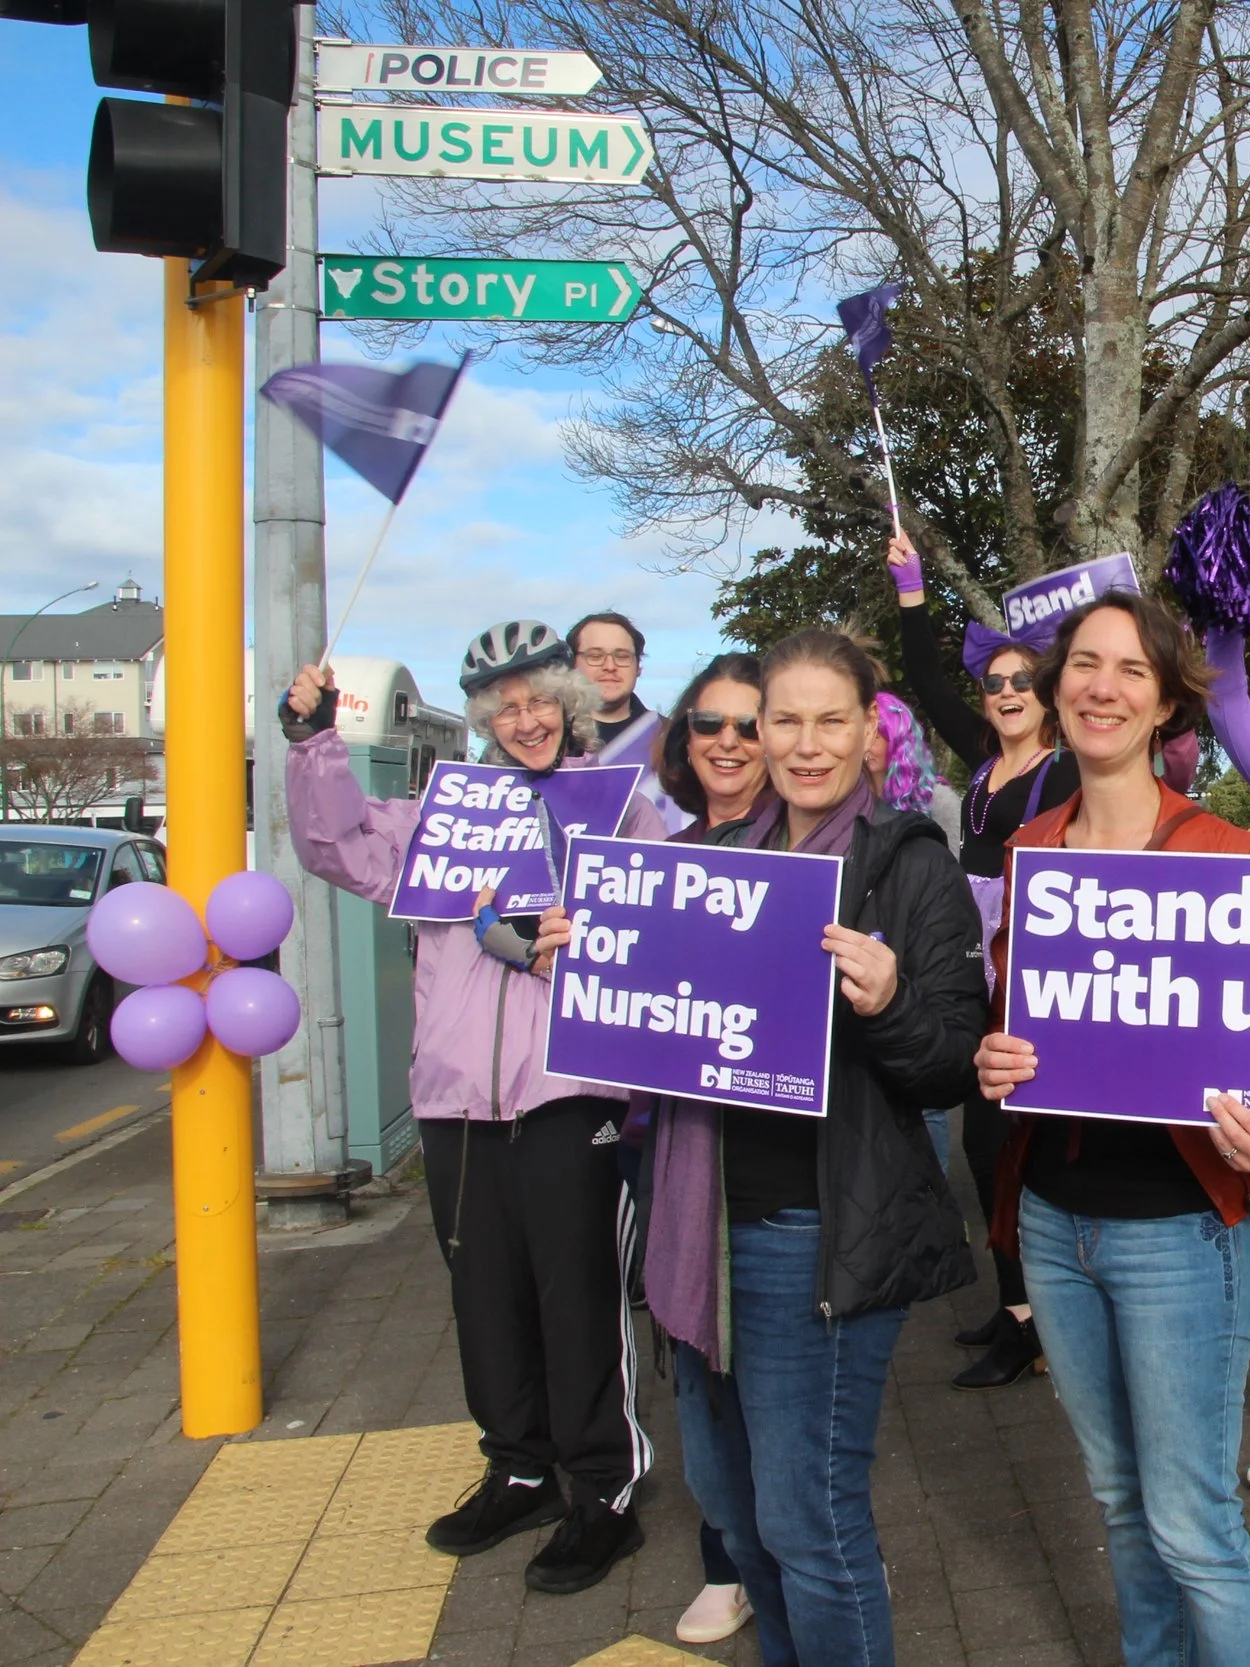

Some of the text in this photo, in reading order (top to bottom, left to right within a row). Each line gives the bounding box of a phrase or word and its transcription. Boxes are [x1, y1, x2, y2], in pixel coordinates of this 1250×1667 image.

[379, 53, 548, 88] POLICE
[340, 118, 609, 170] MUSEUM
[371, 261, 537, 317] Story
[1007, 569, 1097, 632] Stand
[433, 772, 533, 812] Safe
[408, 853, 511, 894] Now
[573, 852, 770, 932] Fair Pay
[568, 908, 640, 965] for
[1021, 949, 1200, 1029] with
[560, 971, 758, 1061] Nursing
[732, 1075, 771, 1089] NURSES
[745, 1070, 771, 1079] ZEALAND
[775, 1083, 815, 1096] TAPUHI
